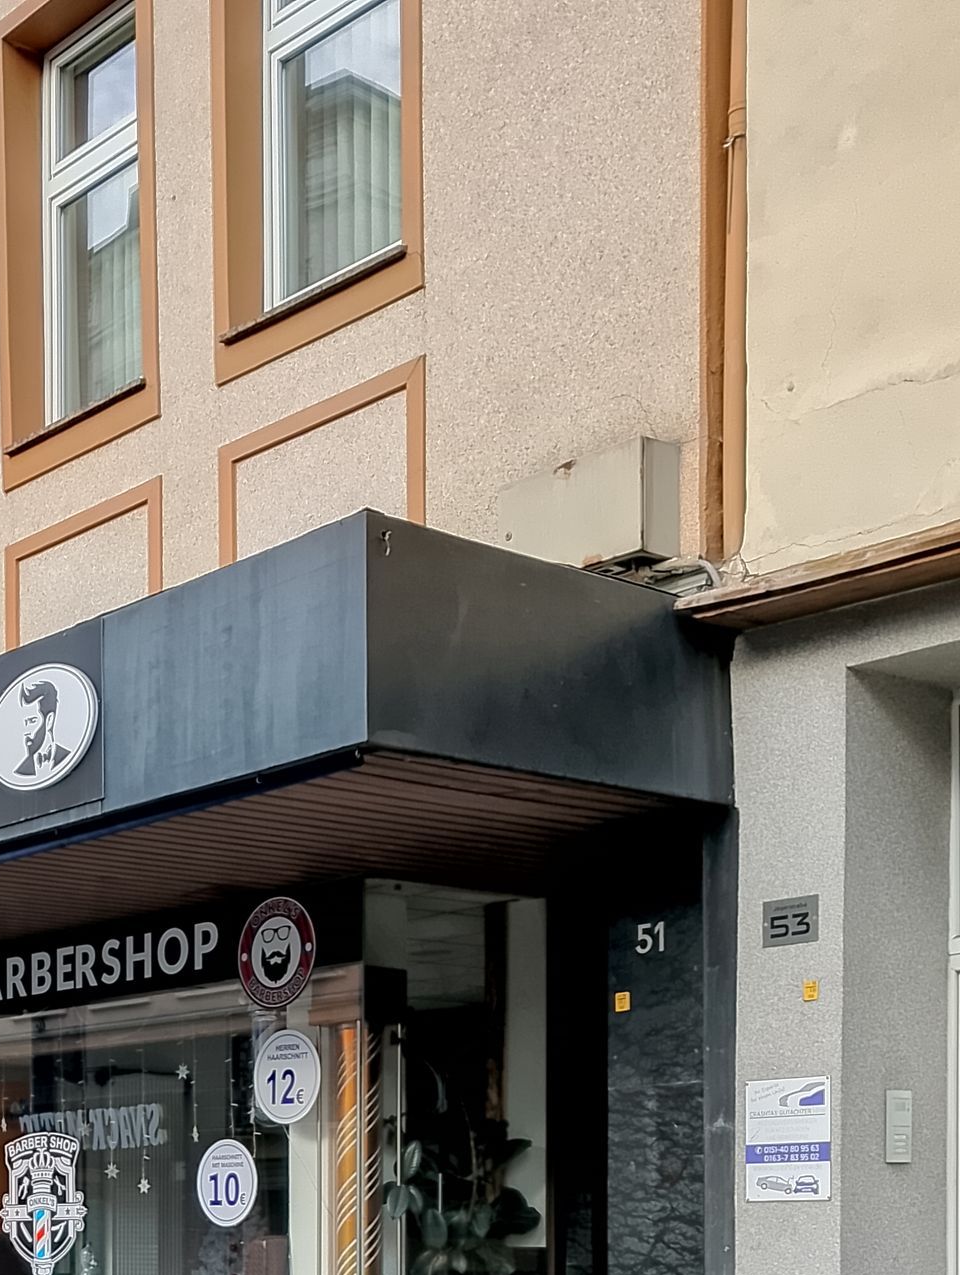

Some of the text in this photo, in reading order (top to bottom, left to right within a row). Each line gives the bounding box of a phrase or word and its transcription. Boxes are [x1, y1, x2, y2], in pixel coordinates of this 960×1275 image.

[770, 911, 811, 940] 53
[634, 920, 666, 955] 51
[8, 1135, 78, 1156] BARBER SHOP
[789, 1145, 800, 1153] 80
[800, 1144, 810, 1152] 95
[28, 1196, 57, 1209] ONKEL'S
